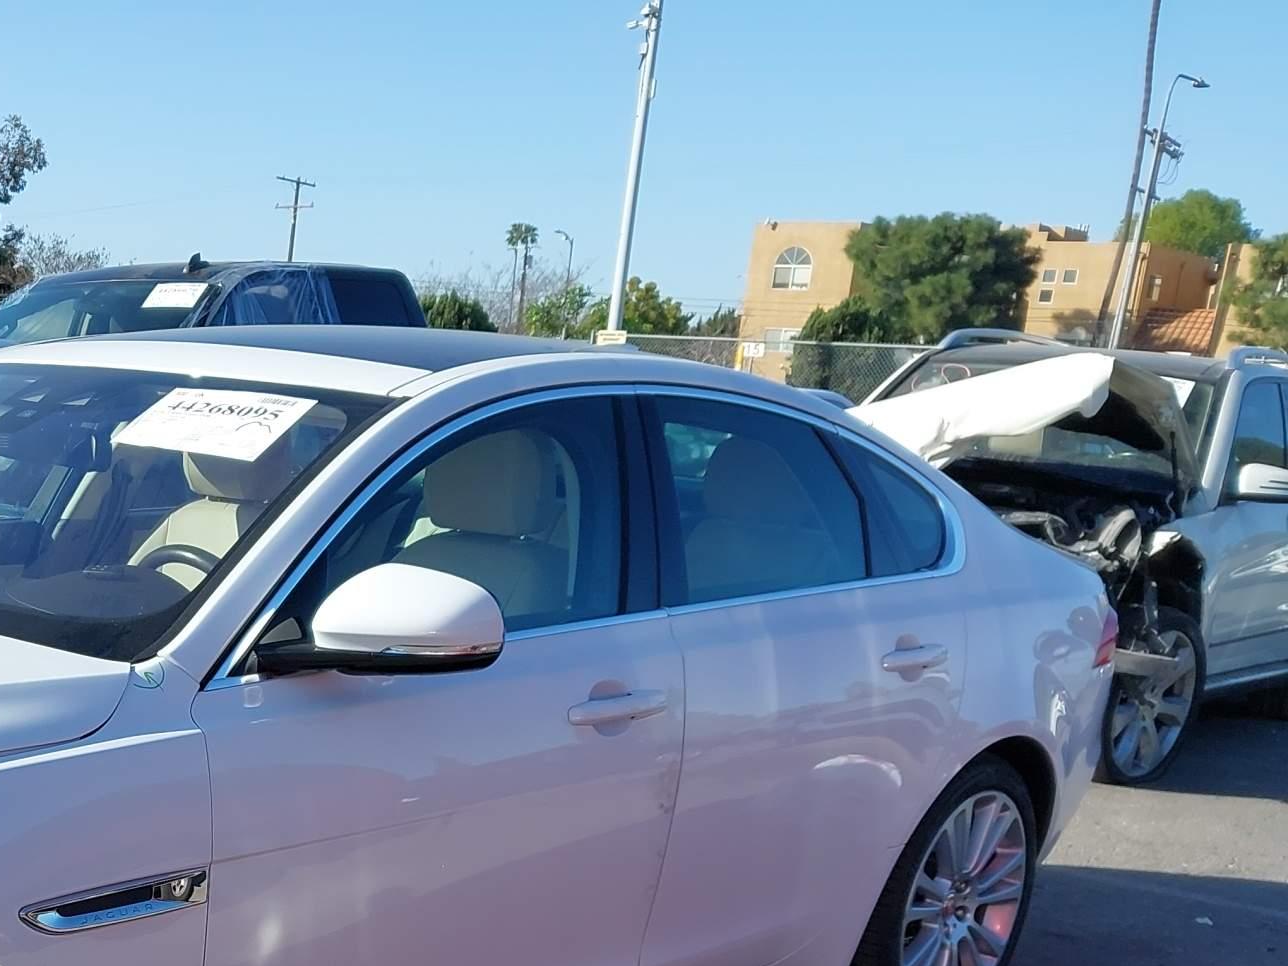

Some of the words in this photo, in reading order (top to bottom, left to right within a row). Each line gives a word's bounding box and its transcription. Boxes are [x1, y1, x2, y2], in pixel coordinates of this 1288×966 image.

[746, 344, 760, 355] 15
[168, 400, 285, 421] 44268095
[80, 903, 153, 925] JAGUAR
